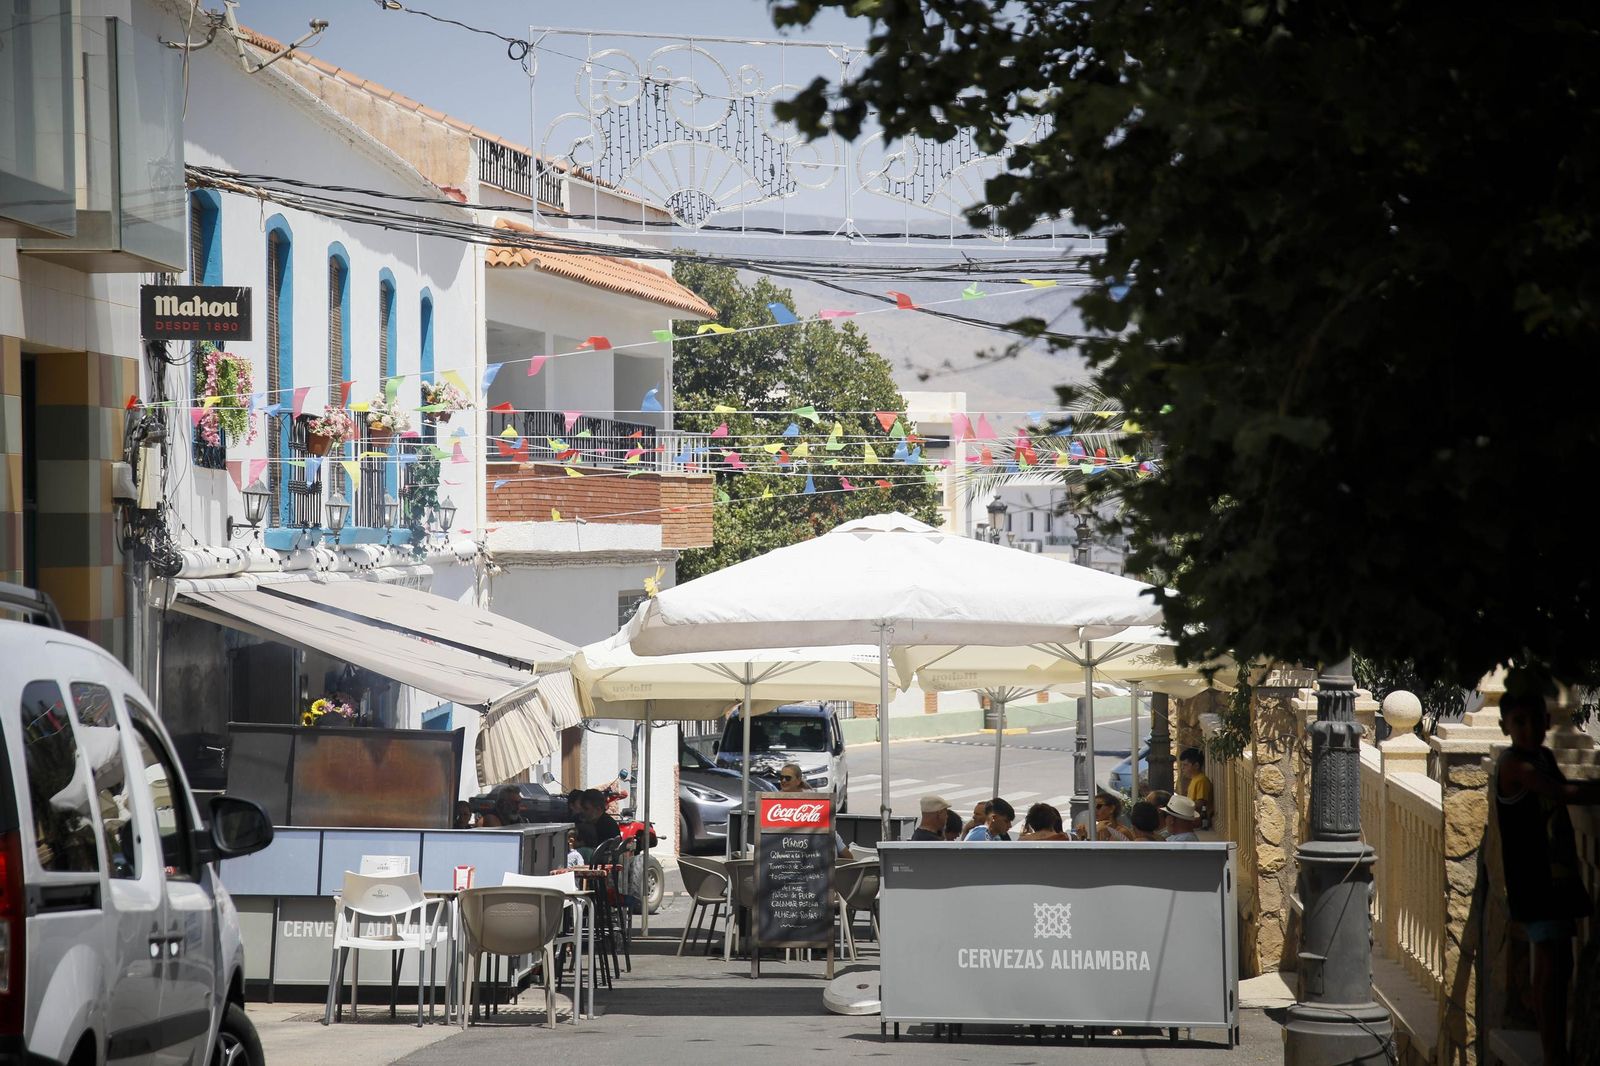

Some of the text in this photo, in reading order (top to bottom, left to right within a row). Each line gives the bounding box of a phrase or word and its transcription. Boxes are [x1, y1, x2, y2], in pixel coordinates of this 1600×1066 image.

[153, 295, 239, 317] Mahou
[155, 321, 239, 331] DESDE 1890
[767, 803, 825, 823] Coca-Cola
[958, 948, 1151, 971] CERVEZAS ALHAMBRA
